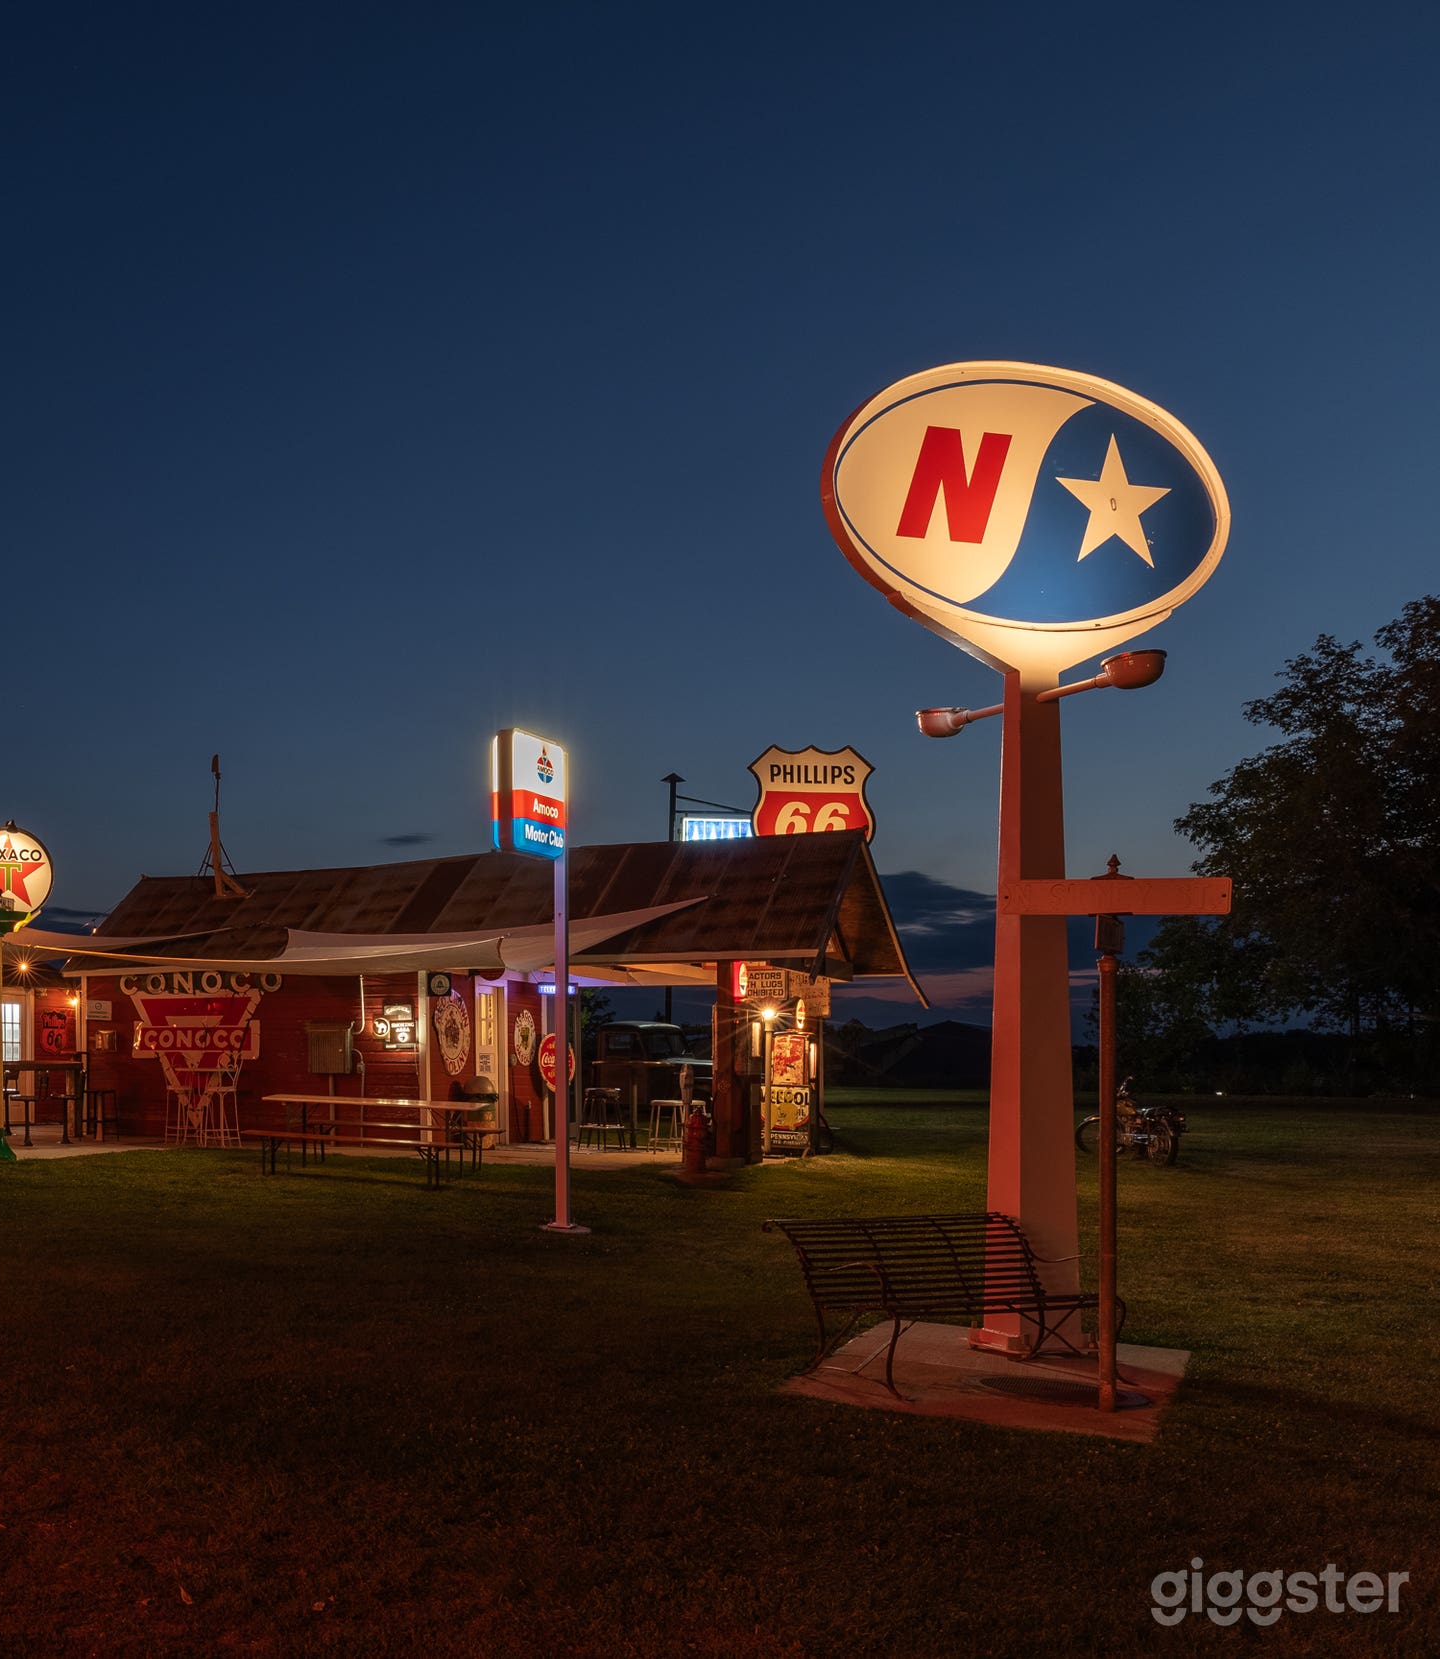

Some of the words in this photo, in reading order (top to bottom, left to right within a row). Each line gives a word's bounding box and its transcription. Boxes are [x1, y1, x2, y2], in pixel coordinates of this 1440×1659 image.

[896, 426, 1012, 544] N
[770, 764, 855, 785] PHILLIPS
[533, 798, 558, 818] Amoco
[775, 801, 850, 836] 66
[525, 824, 548, 844] Motor
[549, 830, 564, 849] Club
[119, 970, 283, 996] CONOCO
[749, 972, 782, 980] ACTORS
[143, 1029, 245, 1049] CONOCO
